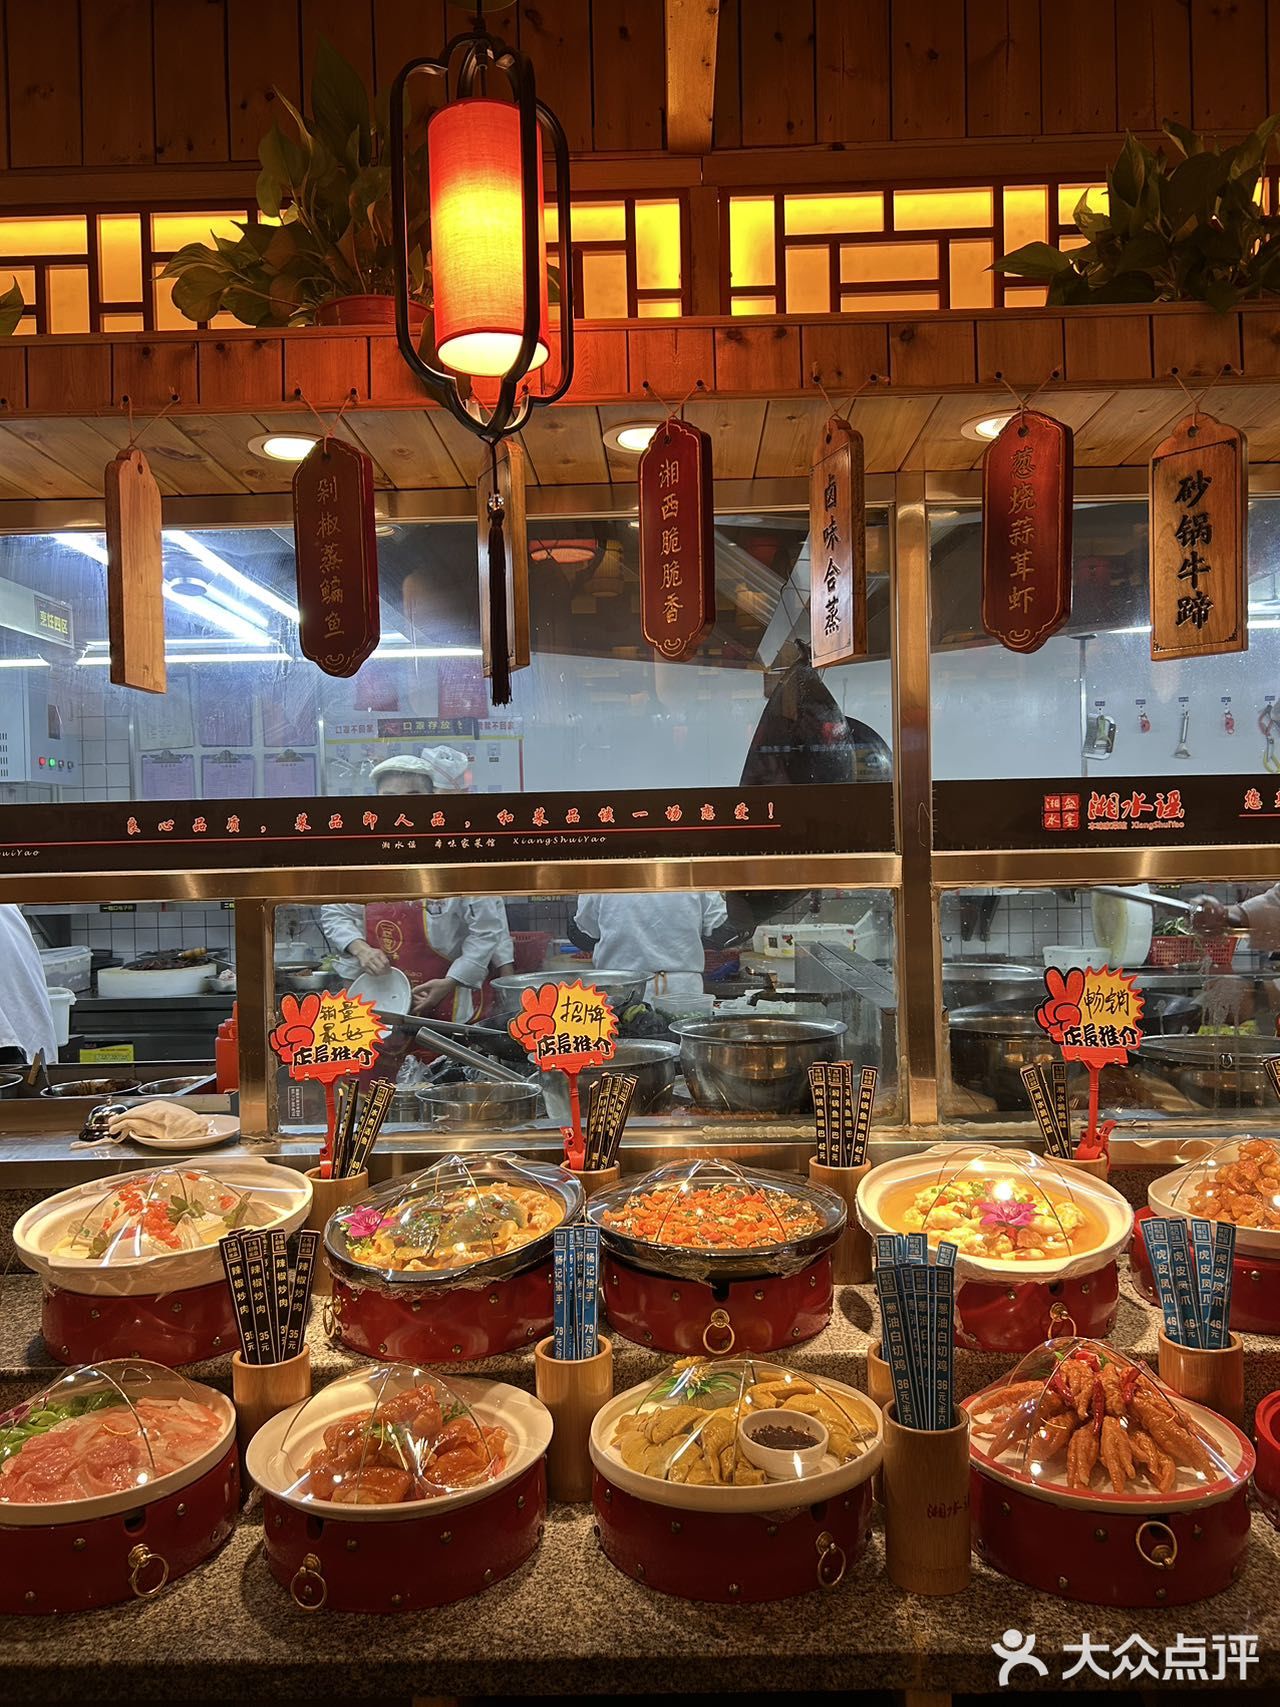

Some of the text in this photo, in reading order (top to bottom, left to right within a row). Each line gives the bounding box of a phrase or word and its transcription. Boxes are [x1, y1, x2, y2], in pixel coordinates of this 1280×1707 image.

[316, 475, 345, 638] 剁椒蒸鳊鱼
[658, 459, 684, 625] 湘西脆脆香
[822, 472, 842, 637] 卤味合蒸
[1173, 472, 1216, 632] 砂锅牛蹄
[320, 1001, 365, 1023] 销量
[320, 1022, 374, 1045] 最好
[560, 995, 606, 1037] 招牌
[231, 1265, 249, 1315] 辣椒炒肉
[251, 1265, 266, 1314] 辣椒炒肉
[259, 1330, 270, 1352] 35元
[276, 1258, 288, 1308] 辣椒炒肉
[293, 1261, 309, 1312] 辣椒炒肉
